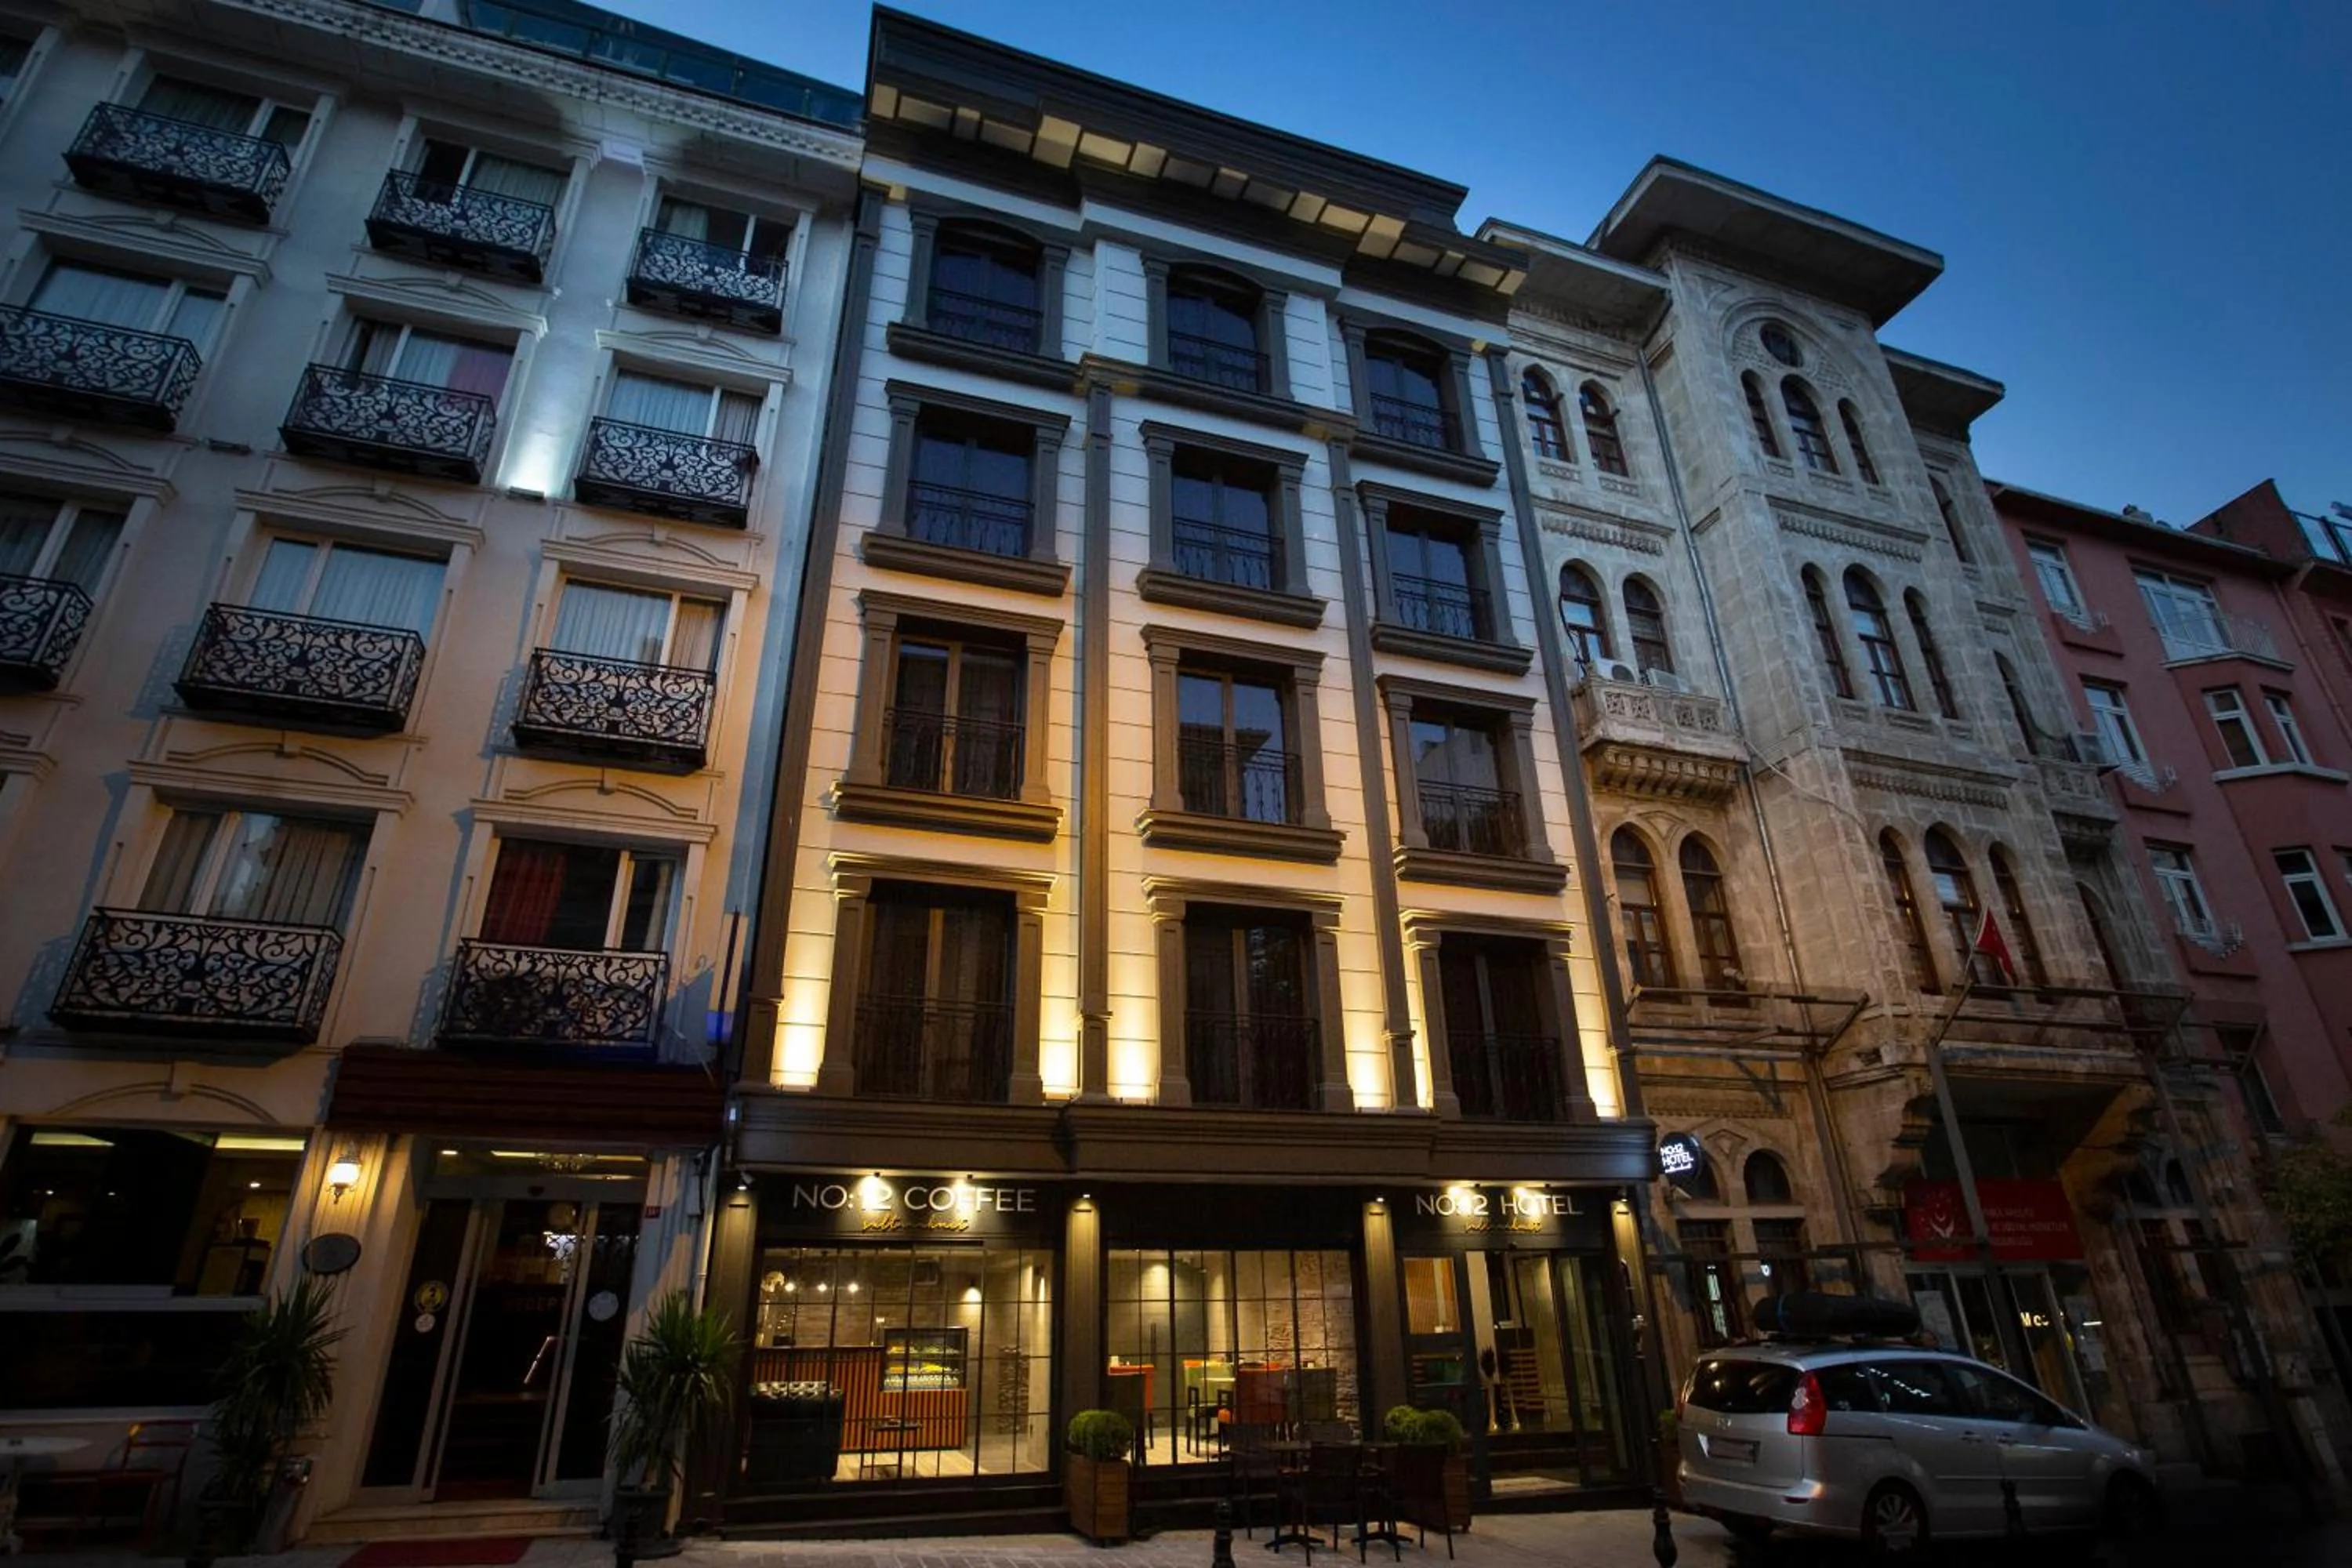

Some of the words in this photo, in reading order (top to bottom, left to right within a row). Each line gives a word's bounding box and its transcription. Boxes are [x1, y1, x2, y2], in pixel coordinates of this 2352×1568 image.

[1661, 1151, 1694, 1167] HOTEL
[793, 1183, 893, 1210] NO:2
[904, 1185, 1036, 1212] COFFEE
[1415, 1194, 1489, 1216] NO2
[1501, 1193, 1584, 1216] HOTEL
